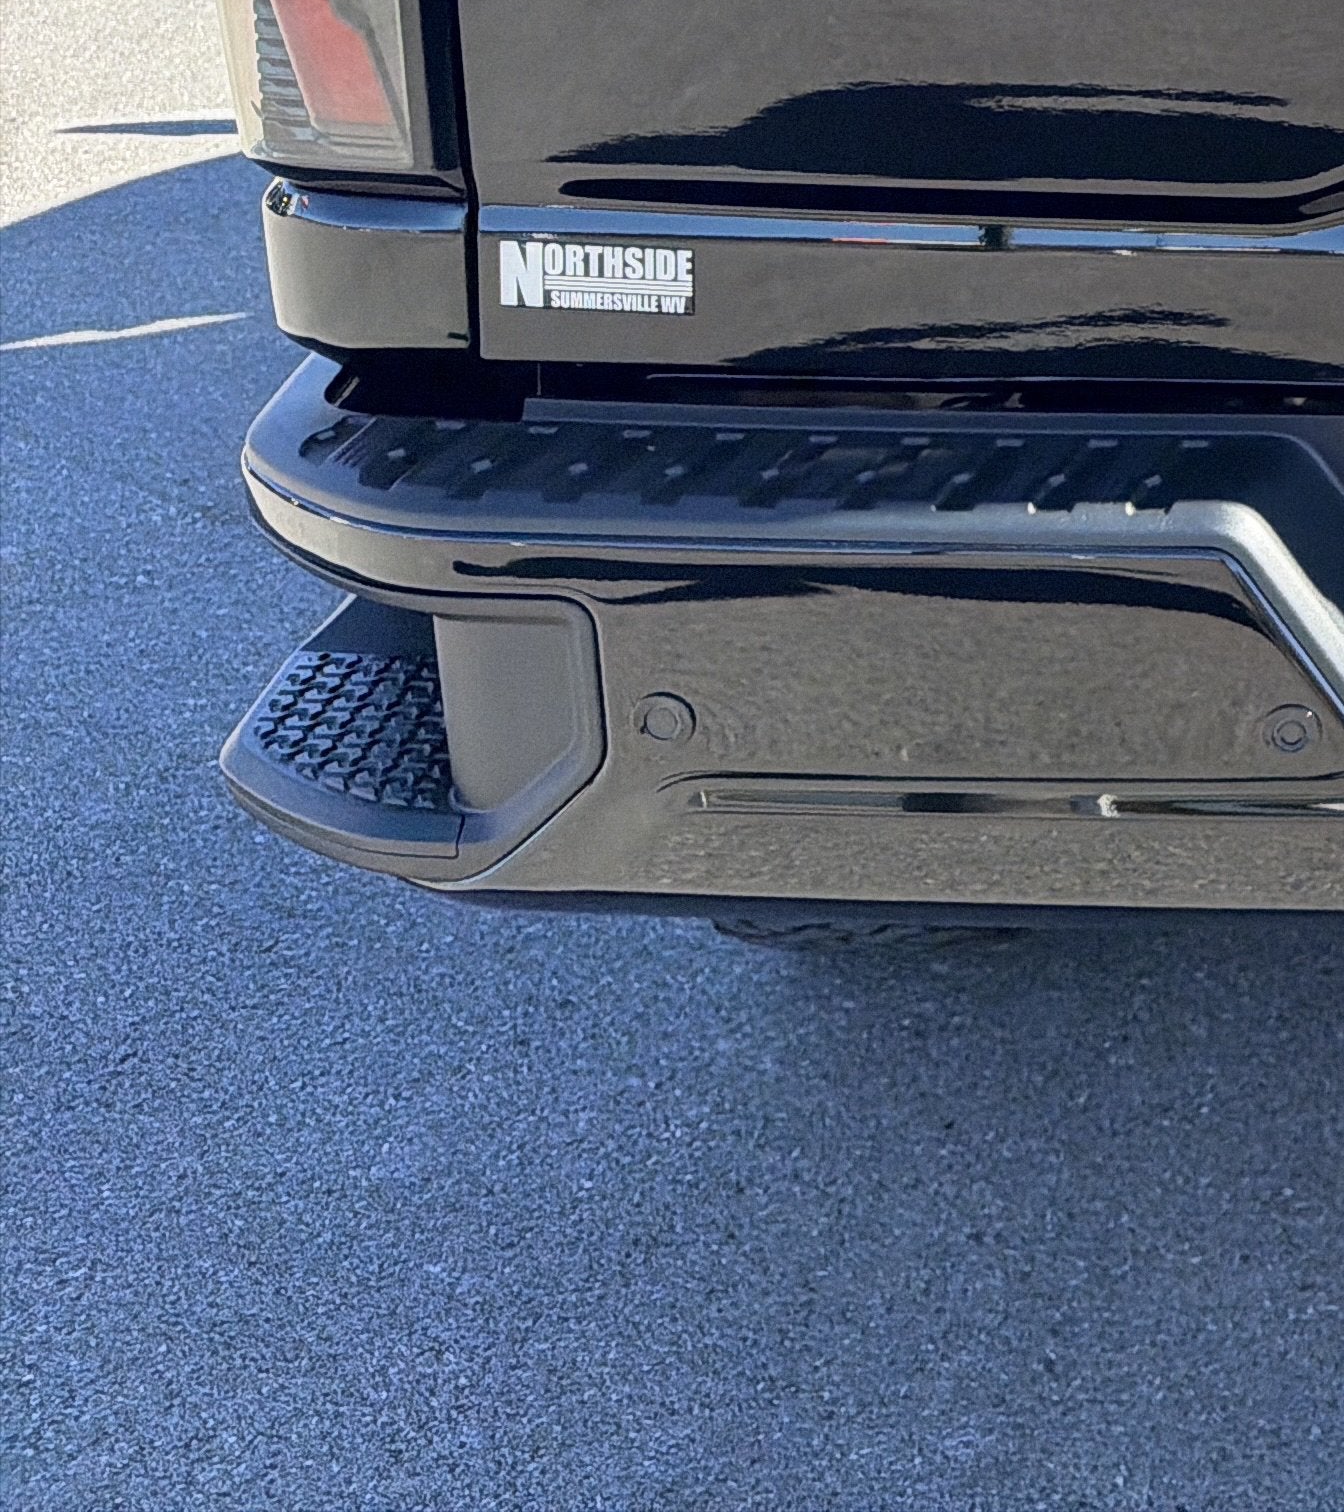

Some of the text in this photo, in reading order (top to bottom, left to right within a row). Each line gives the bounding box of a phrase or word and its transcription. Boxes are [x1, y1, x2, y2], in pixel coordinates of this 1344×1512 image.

[499, 240, 694, 308] NORTHSIDE
[550, 290, 686, 314] SUMMERSVILLE WV
